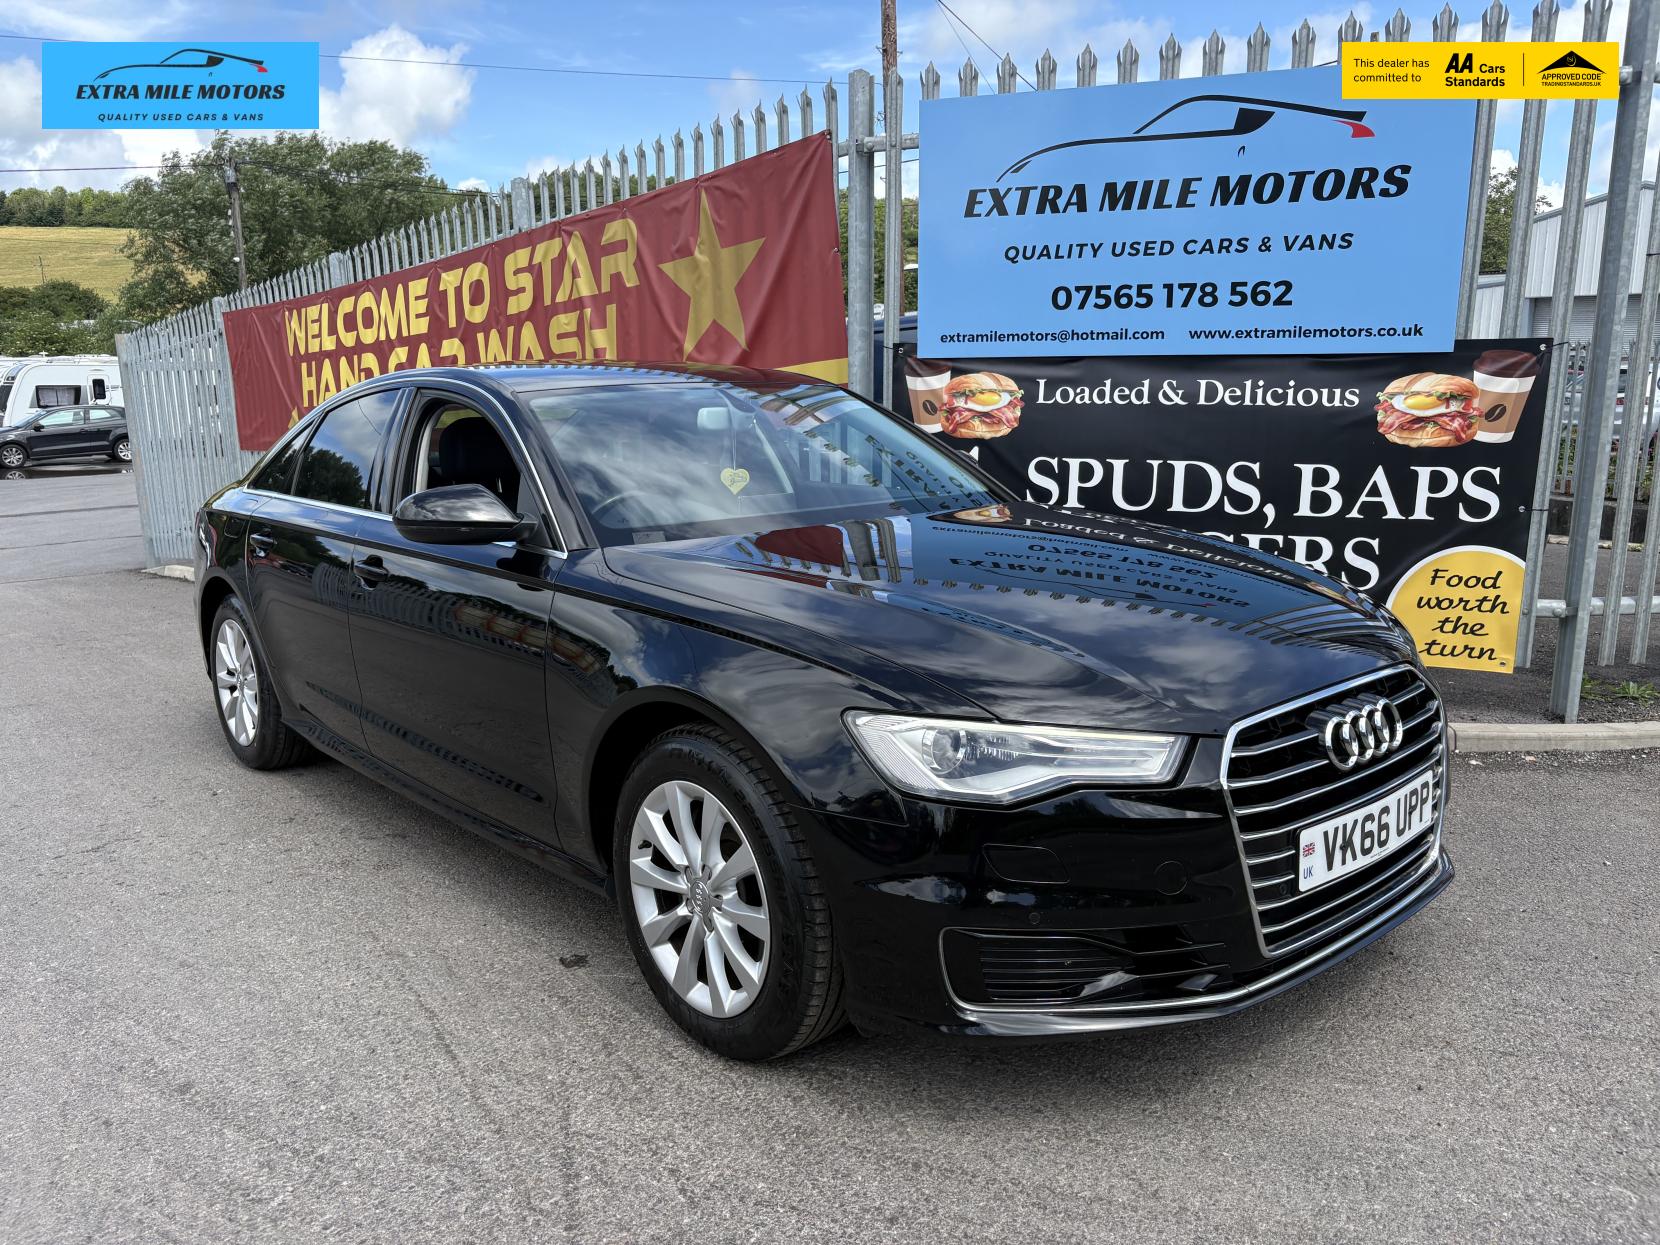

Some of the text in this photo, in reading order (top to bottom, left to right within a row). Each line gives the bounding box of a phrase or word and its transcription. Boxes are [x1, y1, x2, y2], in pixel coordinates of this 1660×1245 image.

[963, 164, 1412, 219] EXTRA MILE MOTORS
[1003, 232, 1355, 263] QUALITY USED CARS & VANS
[285, 218, 640, 357] WELCOME TO STAR
[1050, 280, 1294, 311] 07565 178 562
[940, 324, 1424, 344] extramilemotors@hotmail.com www.extramilemotors.co.uk
[301, 352, 381, 408] HAND
[476, 303, 618, 364] WASH
[1036, 378, 1360, 409] Loaded & Delicious
[1026, 456, 1501, 527] SPUDS, BAPS
[1428, 567, 1503, 592] Food
[1416, 590, 1509, 615] worth
[1432, 616, 1486, 638] the
[1418, 639, 1498, 662] turn
[1323, 780, 1430, 872] VK66 UPP
[1303, 866, 1314, 880] UK
